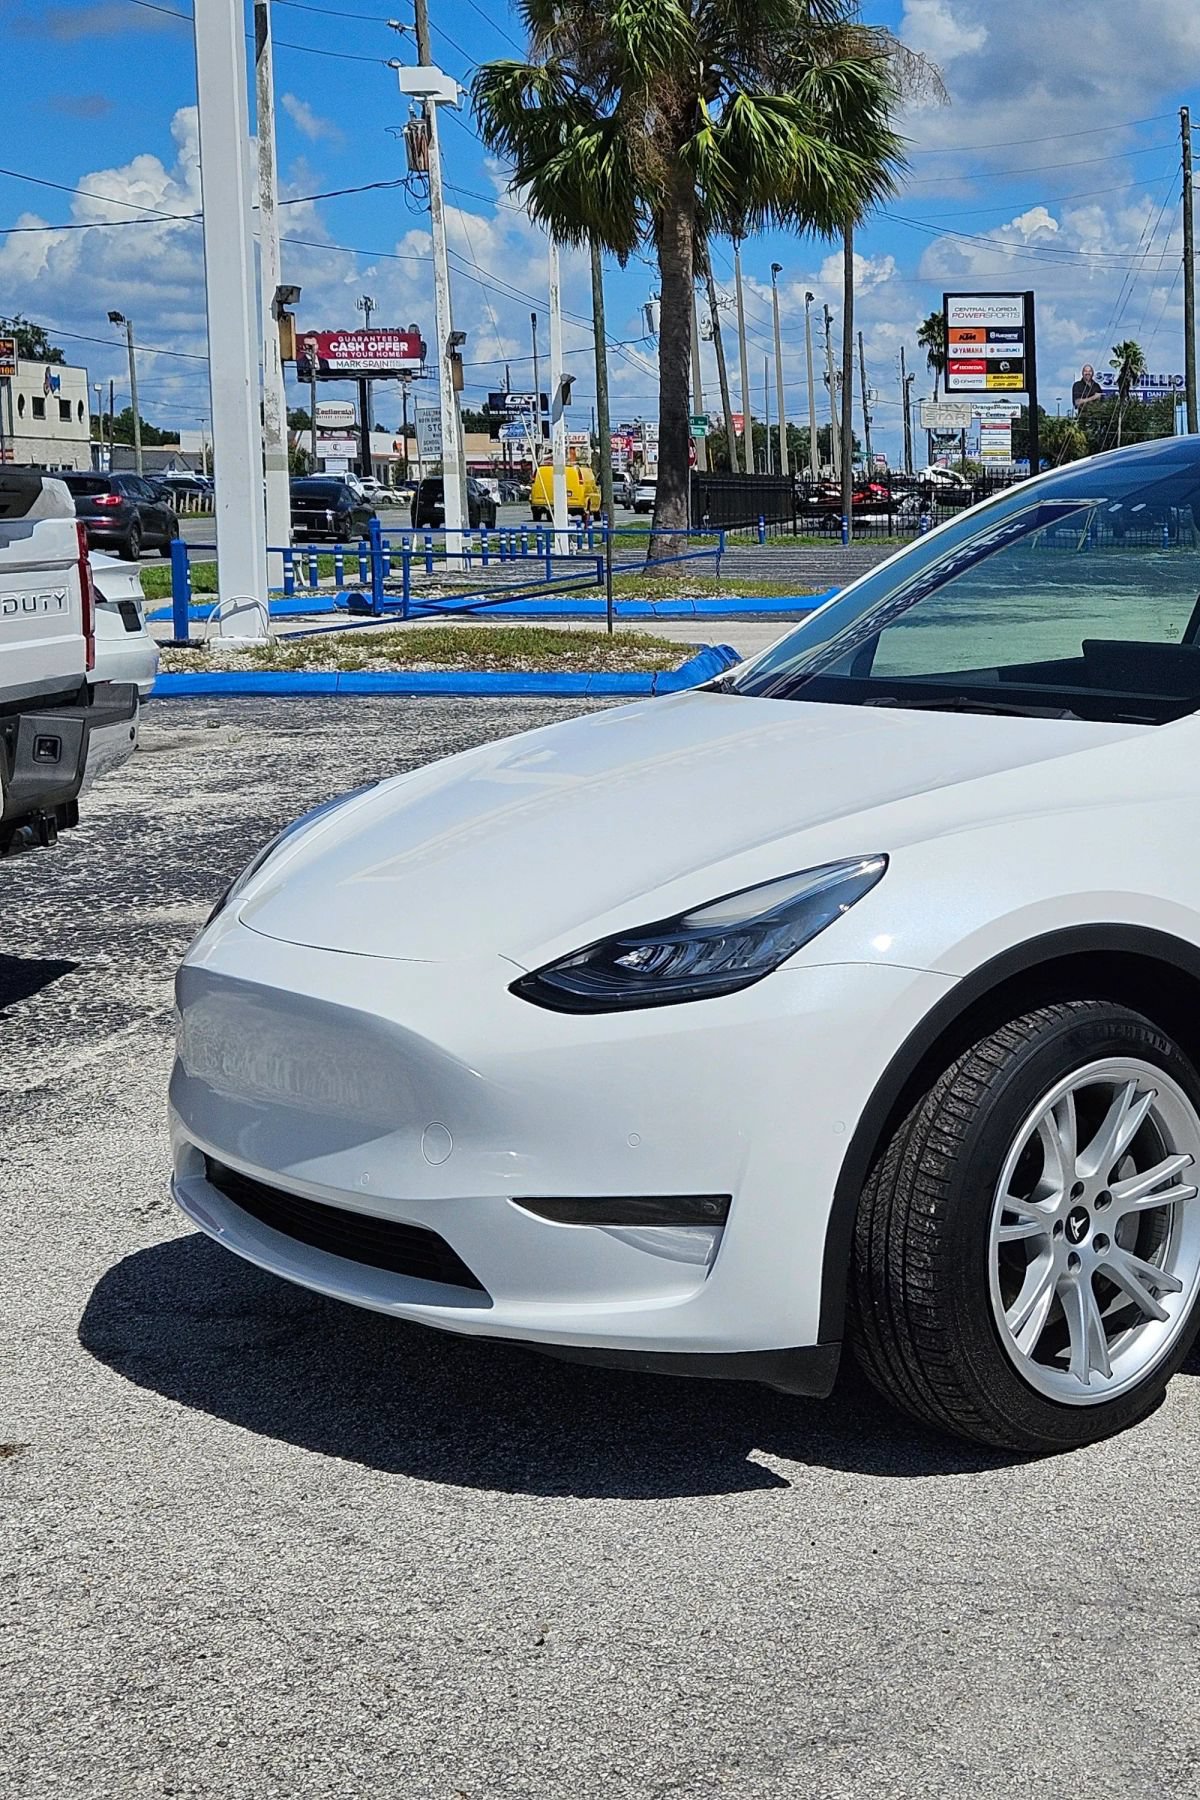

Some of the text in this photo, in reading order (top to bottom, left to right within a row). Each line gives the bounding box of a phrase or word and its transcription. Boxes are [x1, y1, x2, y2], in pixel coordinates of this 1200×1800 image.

[329, 341, 409, 352] CASH OFFER
[336, 360, 361, 368] MARK
[362, 360, 389, 368] SPAIN
[2, 592, 66, 615] DUTY
